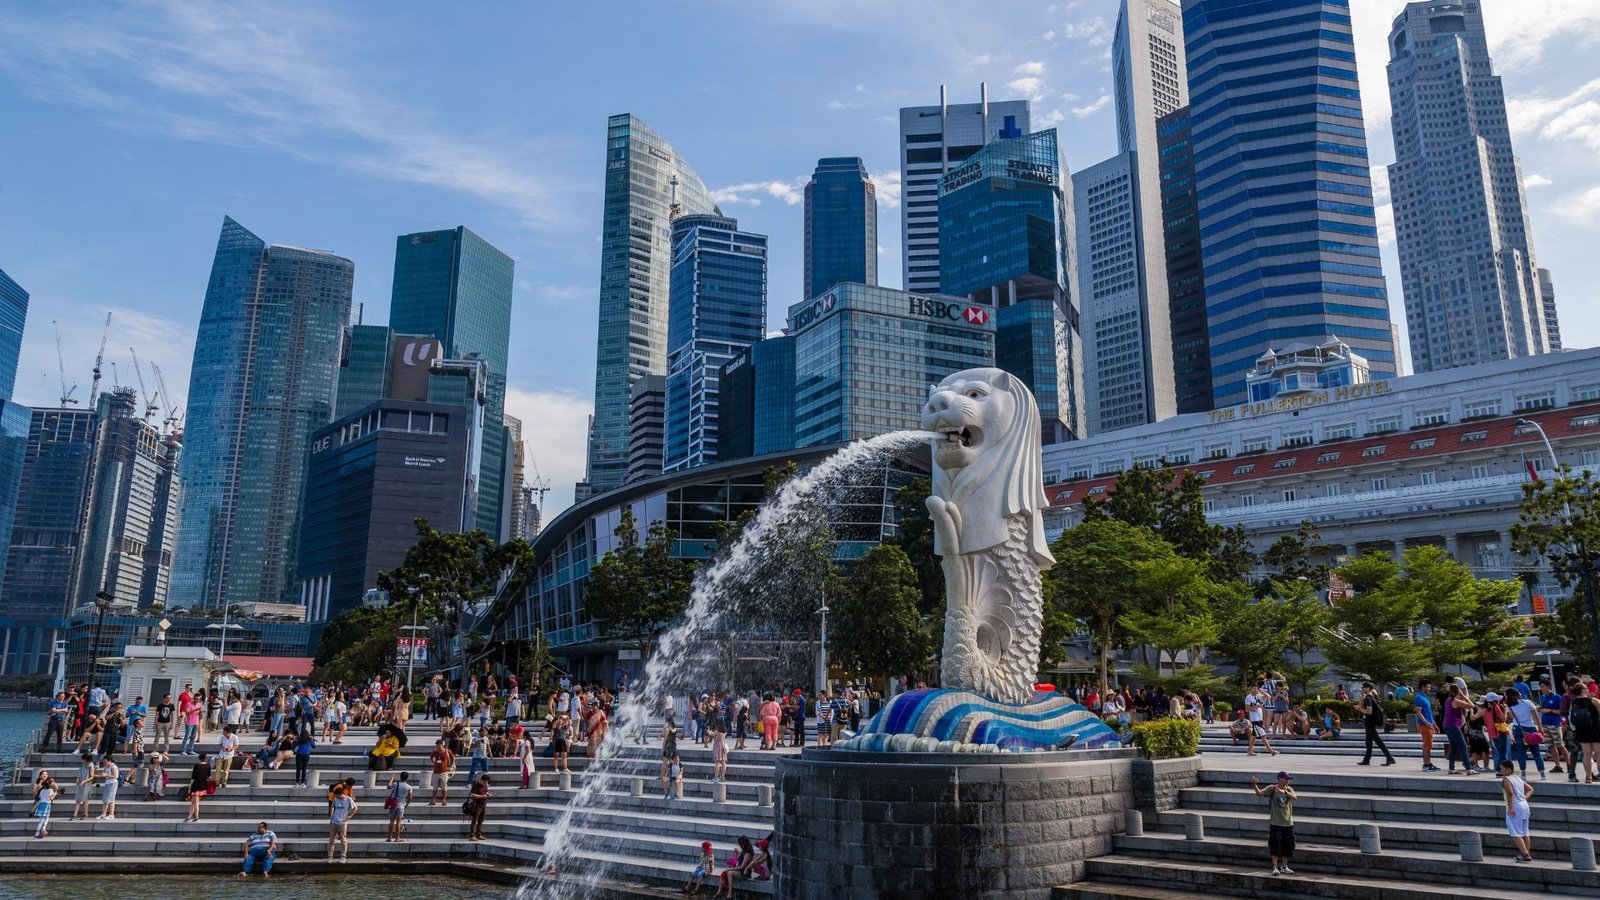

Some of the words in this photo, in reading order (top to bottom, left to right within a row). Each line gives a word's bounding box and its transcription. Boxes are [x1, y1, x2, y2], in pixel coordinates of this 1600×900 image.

[943, 161, 981, 184] STRAITS
[1005, 168, 1054, 185] TRADING
[1007, 159, 1053, 174] STRAITS
[944, 170, 983, 193] TRADING
[793, 301, 822, 331] HSBC
[908, 296, 961, 321] HSBC
[1207, 409, 1236, 424] THE
[1240, 391, 1328, 418] FULLERTON
[1335, 380, 1393, 401] HOTEL
